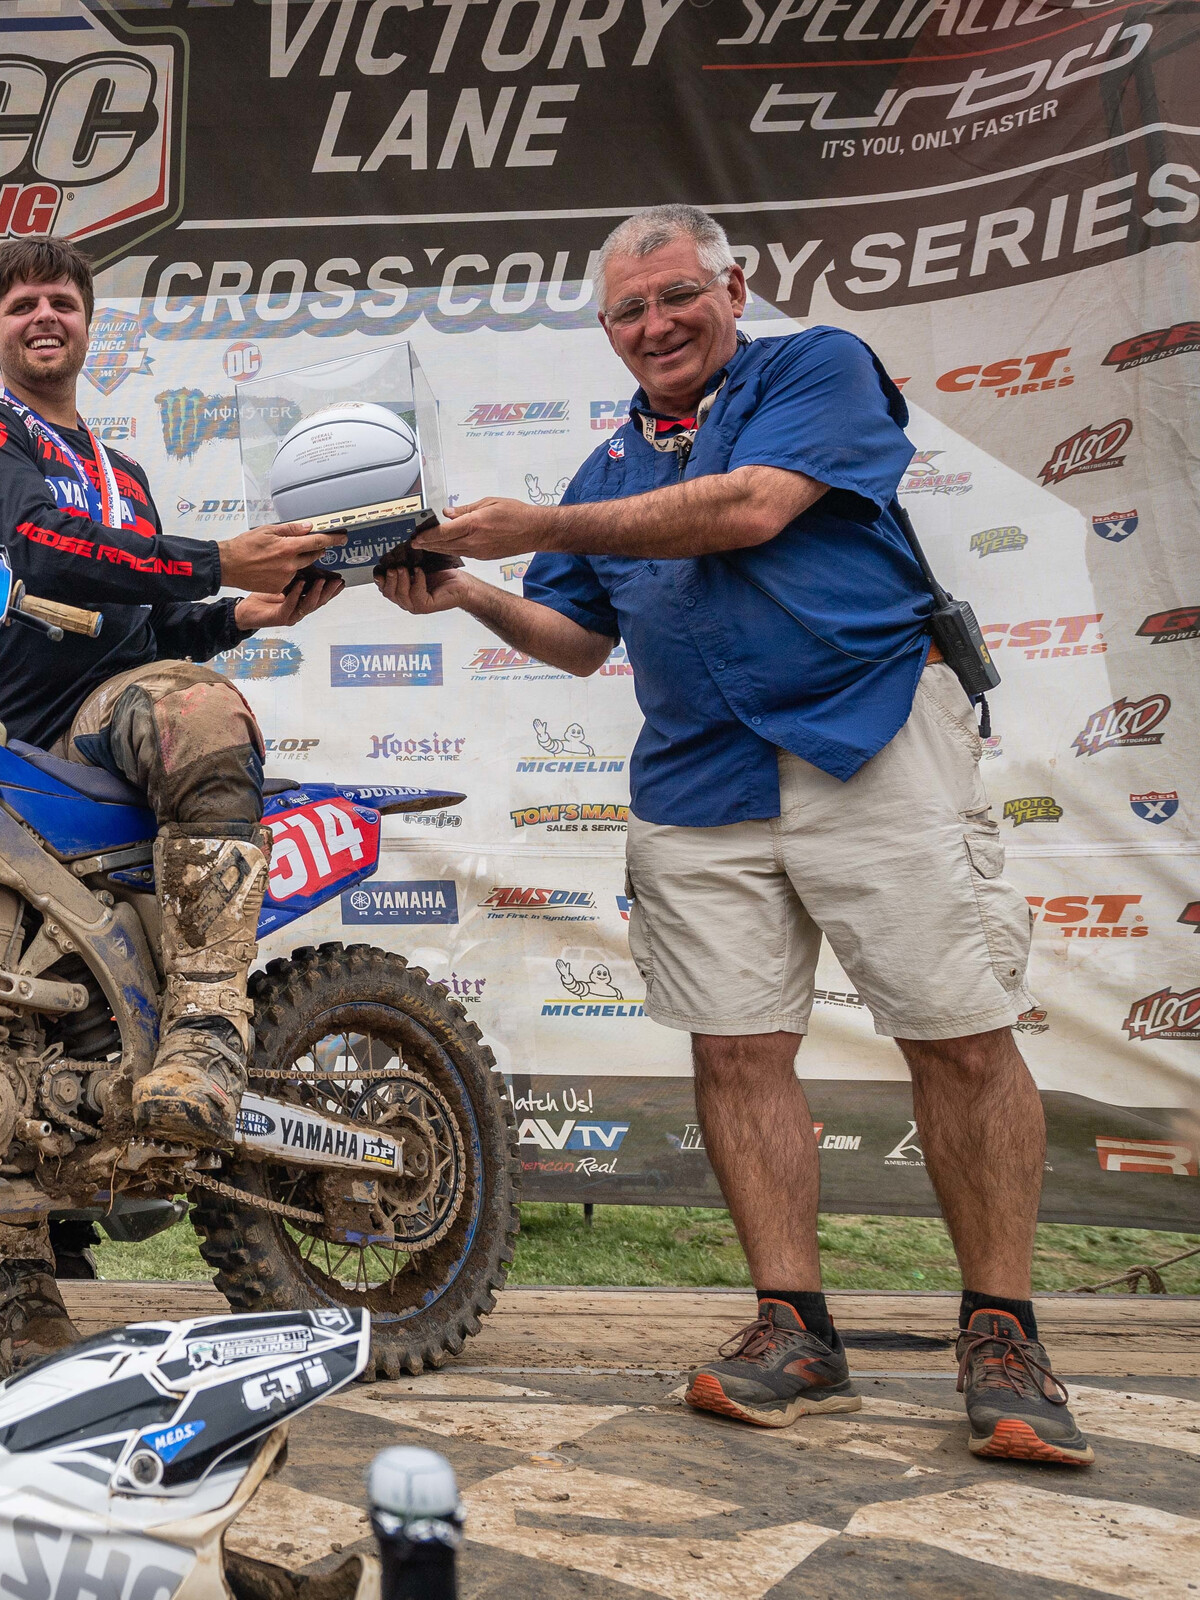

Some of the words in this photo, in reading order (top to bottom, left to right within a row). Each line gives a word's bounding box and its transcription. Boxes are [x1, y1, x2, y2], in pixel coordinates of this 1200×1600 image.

[268, 0, 679, 78] VICTORY
[750, 23, 1153, 132] turbo
[312, 84, 580, 173] LANE
[821, 140, 855, 159] IT'S
[862, 134, 905, 157] YOU,
[912, 124, 968, 150] ONLY
[971, 99, 1059, 141] FASTER
[153, 257, 411, 324] CROSS
[844, 162, 1200, 295] SERIES
[89, 341, 126, 351] GNCC
[227, 345, 260, 381] DC
[935, 347, 1073, 393] CST
[994, 375, 1075, 399] TIRES
[464, 399, 571, 424] AMSOIL
[908, 471, 973, 490] BALLS
[1095, 511, 1137, 523] RACER
[971, 528, 1020, 546] MOTO
[1105, 520, 1129, 538] X
[16, 522, 95, 557] MOOSE
[97, 546, 193, 577] RACING
[979, 535, 1028, 558] TEES
[982, 612, 1104, 650] CST
[1023, 642, 1108, 660] TIRES
[357, 652, 432, 672] YAMAHA
[365, 732, 467, 759] Hoosier
[515, 760, 625, 773] MICHELIN
[359, 787, 429, 799] DUNLOP
[511, 803, 578, 828] TOM'S
[1005, 797, 1053, 814] MOTO
[1015, 806, 1063, 824] TEES
[1143, 801, 1173, 819] X
[546, 824, 577, 832] SALES
[581, 824, 588, 832] &
[591, 824, 628, 832] SERVIC
[267, 801, 364, 900] 514
[371, 890, 446, 909] YAMAHA
[487, 887, 598, 909] AMSOIL
[543, 914, 598, 922] Synthetics
[1060, 926, 1149, 938] TIRES
[563, 1089, 594, 1114] Us!
[280, 1117, 358, 1160] YAMAHA
[818, 1134, 861, 1150] .COM
[364, 1143, 395, 1159] DP
[575, 1157, 617, 1178] Real.
[154, 1422, 196, 1451] M.E.D.S.
